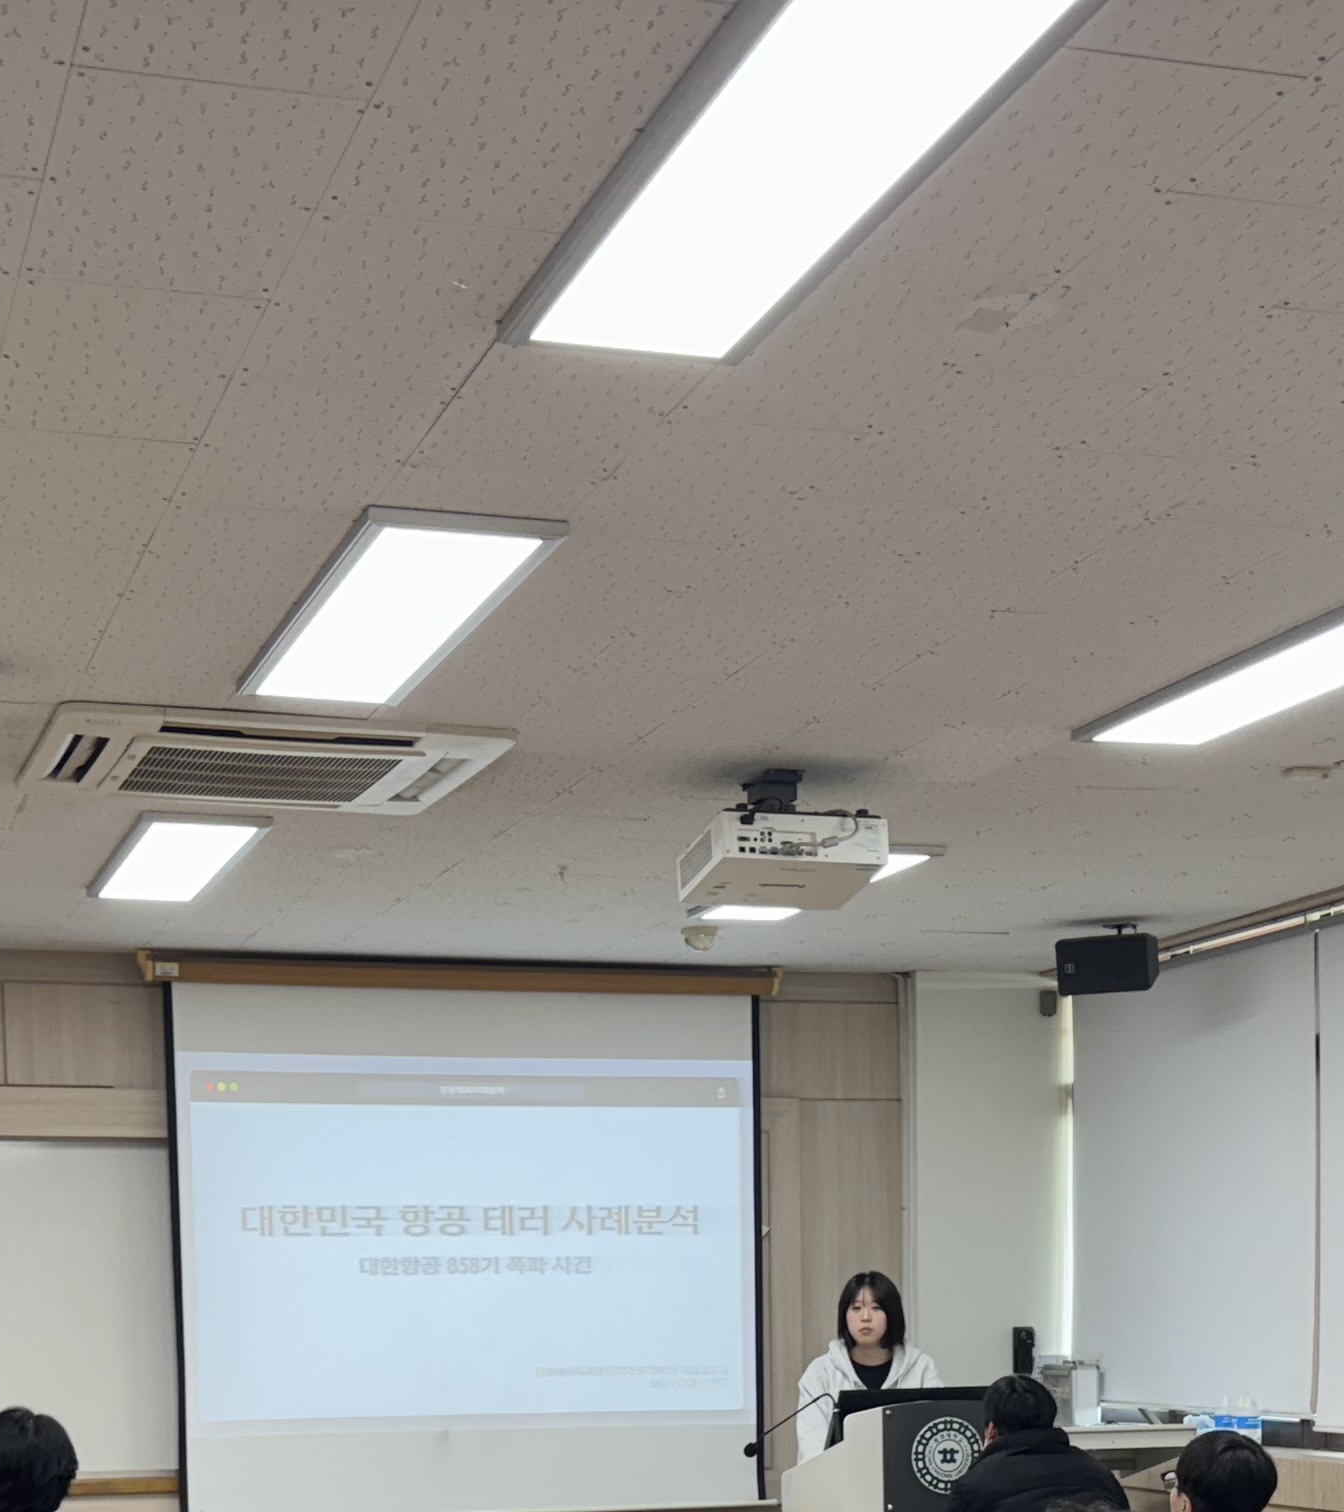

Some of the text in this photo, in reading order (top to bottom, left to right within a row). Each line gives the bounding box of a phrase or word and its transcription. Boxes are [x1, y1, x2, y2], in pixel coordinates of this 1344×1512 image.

[240, 1205, 700, 1237] 대한민국 항공 테러 사례분석
[359, 1256, 593, 1276] 대한항공 858기 폭파 사건
